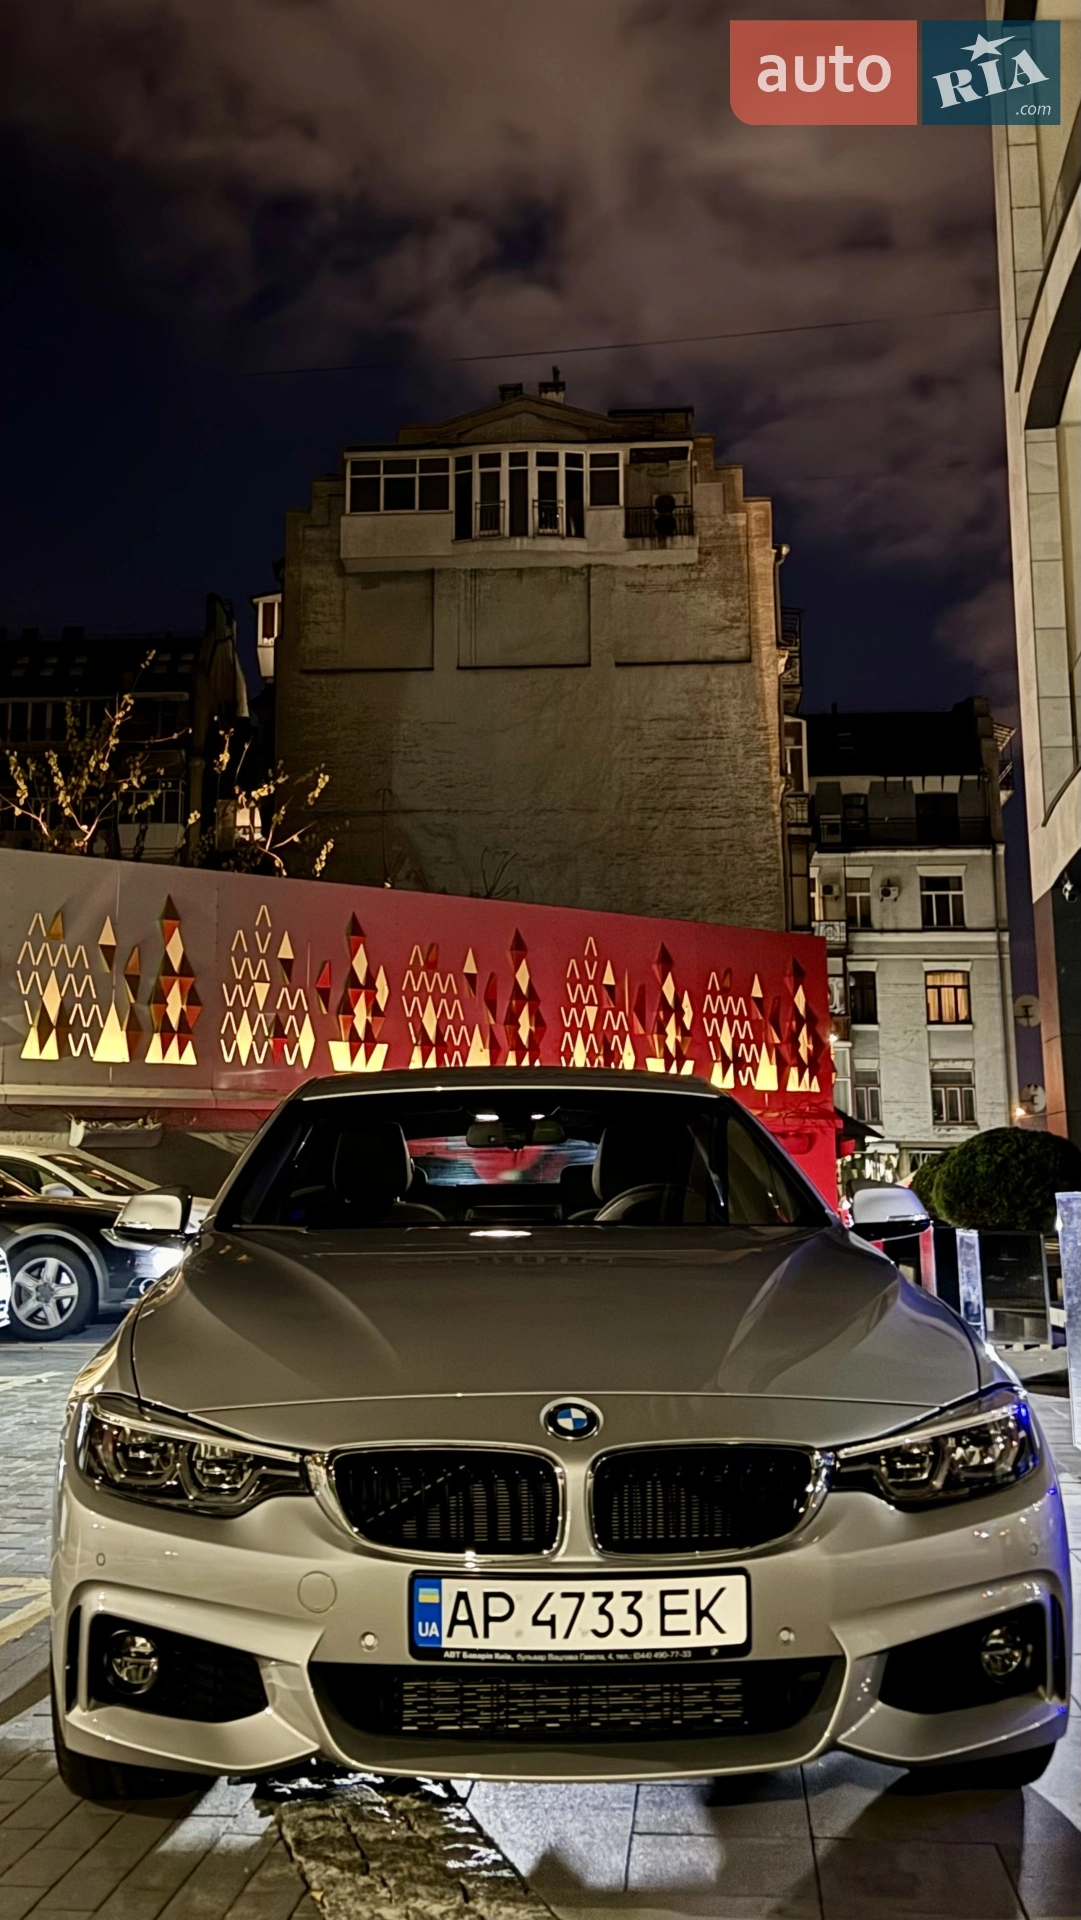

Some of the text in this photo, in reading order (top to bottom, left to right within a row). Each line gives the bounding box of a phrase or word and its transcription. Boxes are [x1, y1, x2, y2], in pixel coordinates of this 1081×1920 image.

[418, 1622, 439, 1637] UA
[446, 1587, 727, 1640] AP 4733 EK
